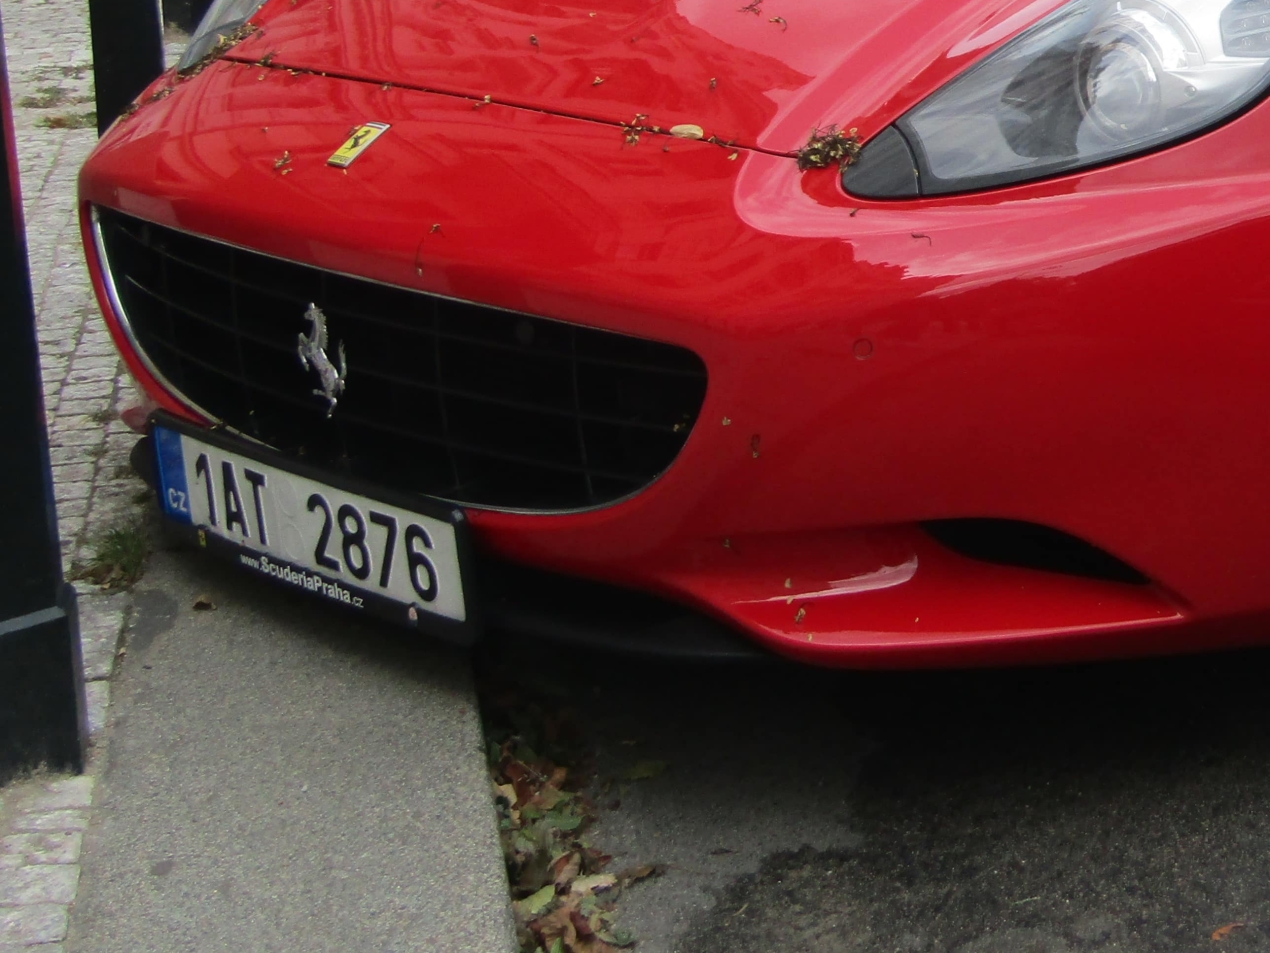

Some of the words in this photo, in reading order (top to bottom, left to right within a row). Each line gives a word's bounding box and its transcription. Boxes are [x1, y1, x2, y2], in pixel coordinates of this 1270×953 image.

[168, 488, 187, 512] CZ
[195, 452, 269, 546] 1AT
[307, 493, 438, 602] 2876
[240, 553, 364, 608] www.ScuderiaPraha.cz
